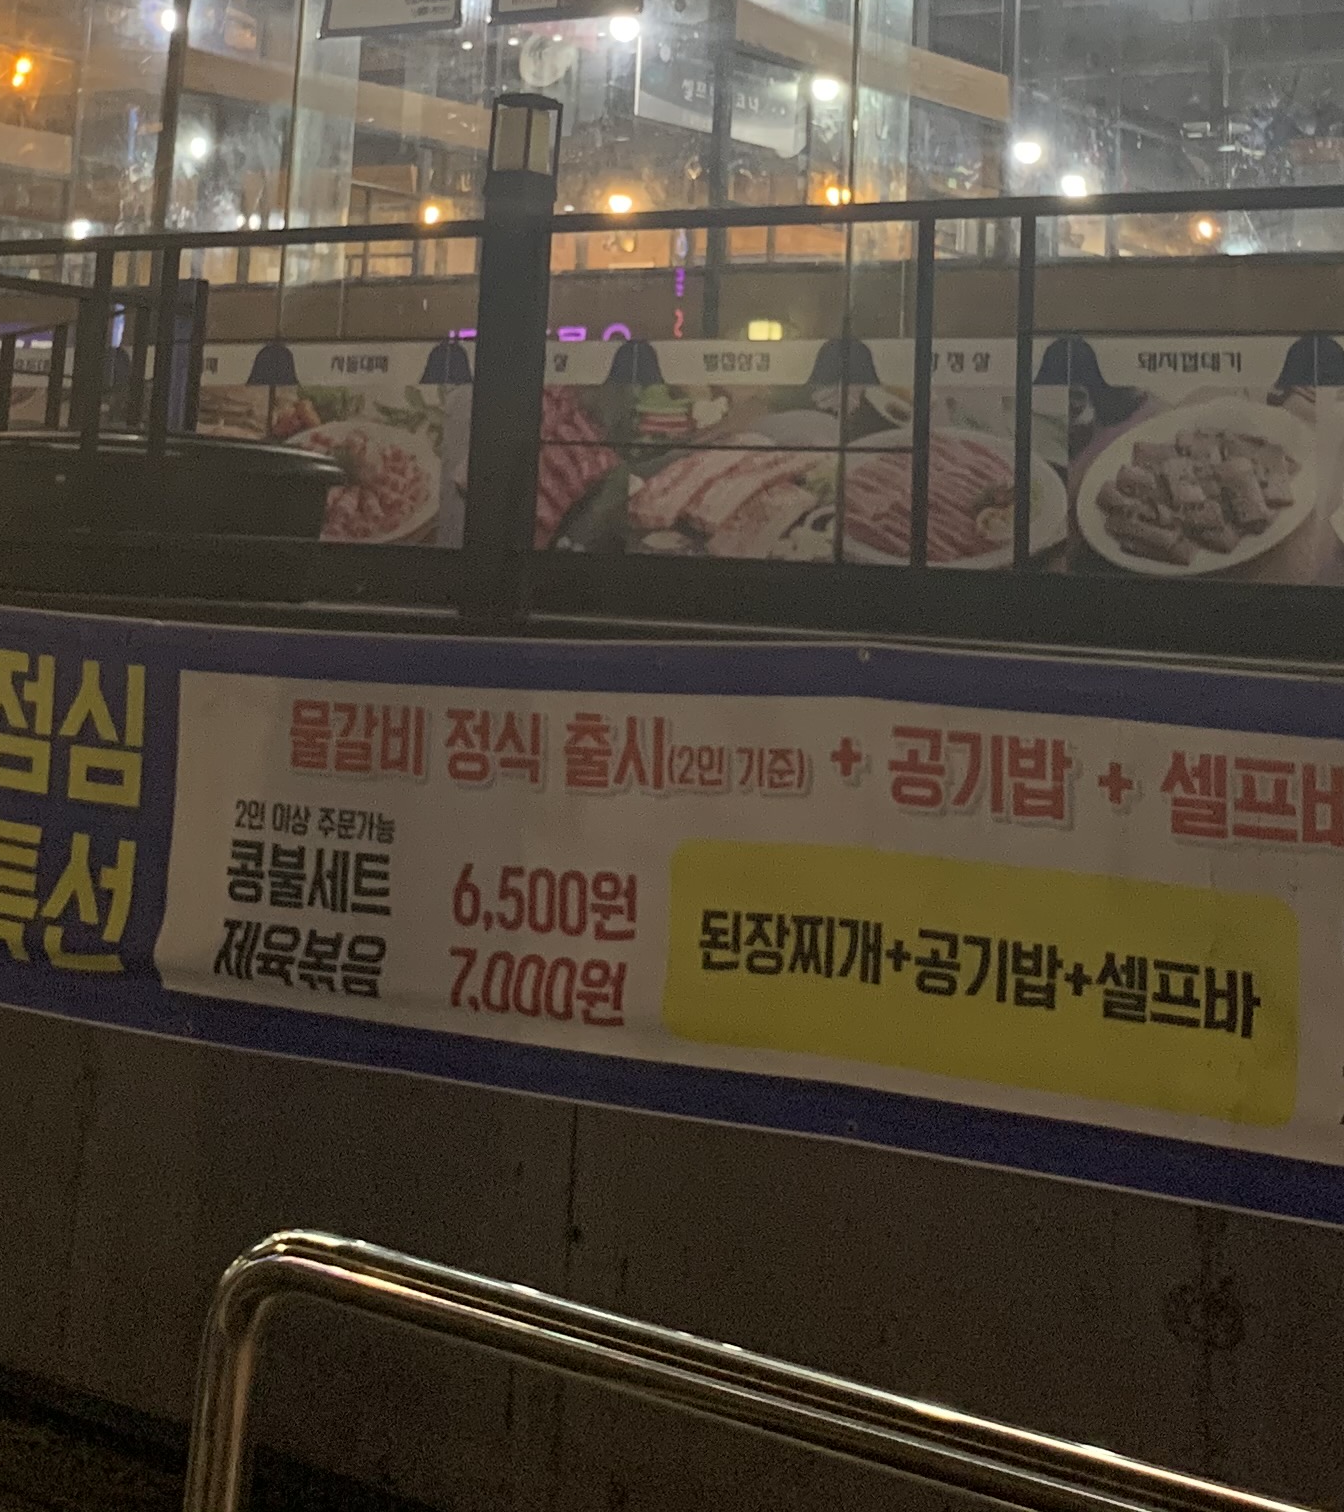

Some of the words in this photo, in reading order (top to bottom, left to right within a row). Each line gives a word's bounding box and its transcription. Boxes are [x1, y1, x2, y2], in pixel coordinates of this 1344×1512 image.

[290, 699, 425, 775] 물갈비
[446, 706, 541, 784] 정식
[564, 712, 664, 791] 출시
[888, 726, 1070, 823] 공기밥
[235, 799, 266, 828] 2인
[271, 805, 312, 834] 이상
[318, 806, 395, 845] 주문가능
[226, 838, 391, 916] 콩불세트
[455, 863, 638, 942] 6,500원
[213, 918, 387, 998] 제육볶음
[449, 946, 625, 1027] 7,000원
[699, 909, 1261, 1038] 된장찌개+공기밥+셀프바
